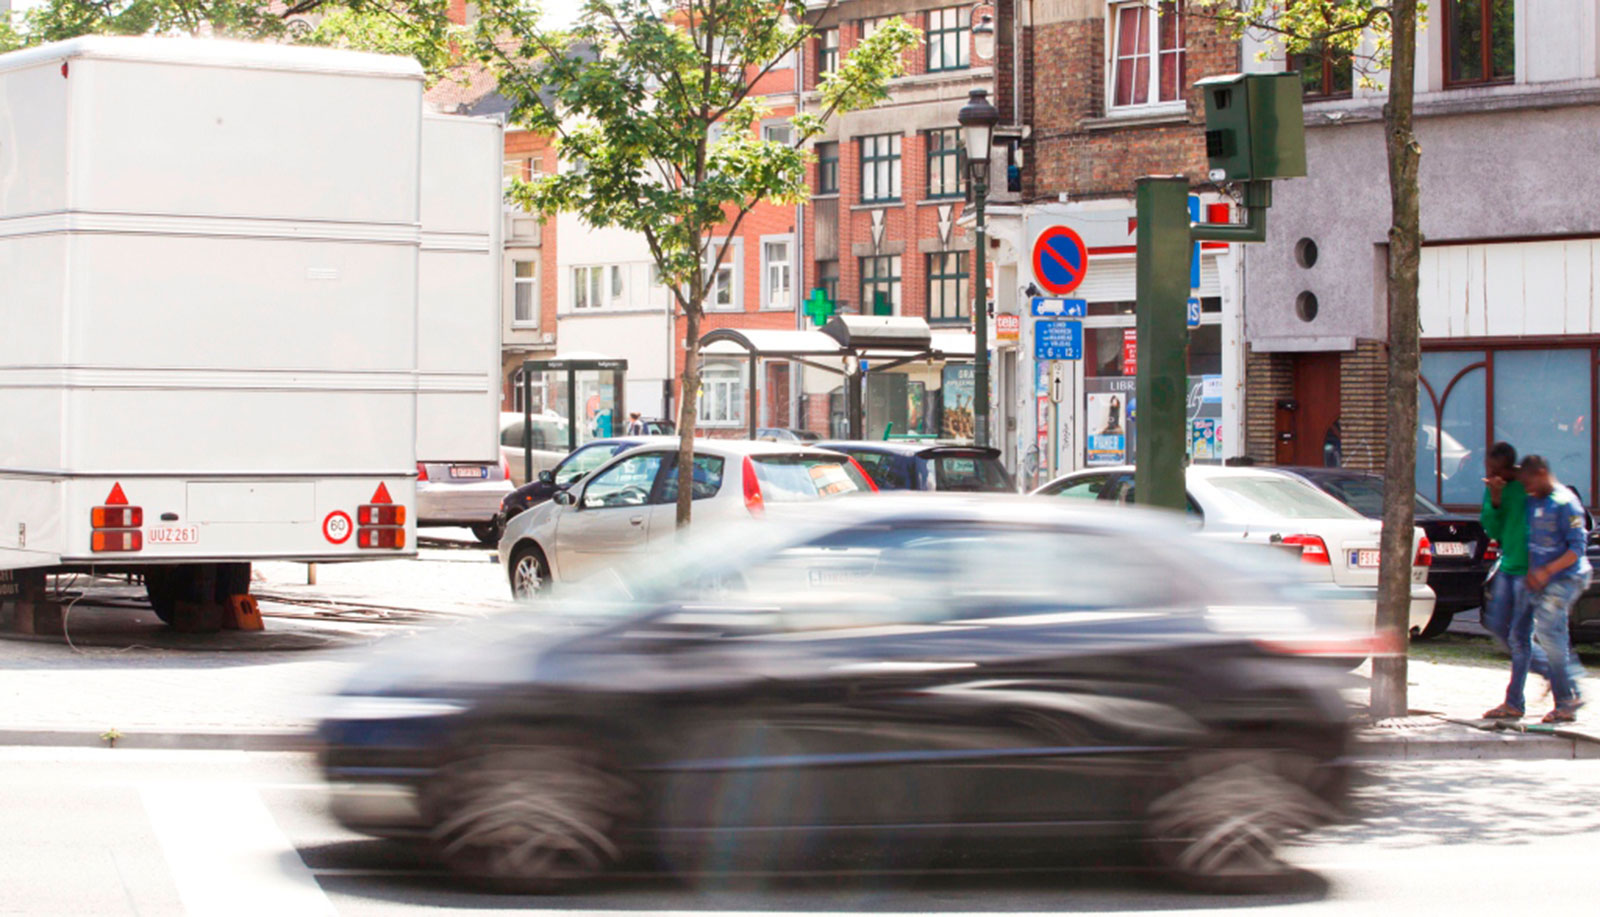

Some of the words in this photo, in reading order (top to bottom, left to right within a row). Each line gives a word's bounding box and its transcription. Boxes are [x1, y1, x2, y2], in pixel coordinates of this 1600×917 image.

[1047, 347, 1054, 357] 6
[1065, 347, 1074, 357] 12
[1110, 381, 1136, 391] LIBR
[330, 518, 346, 531] 60
